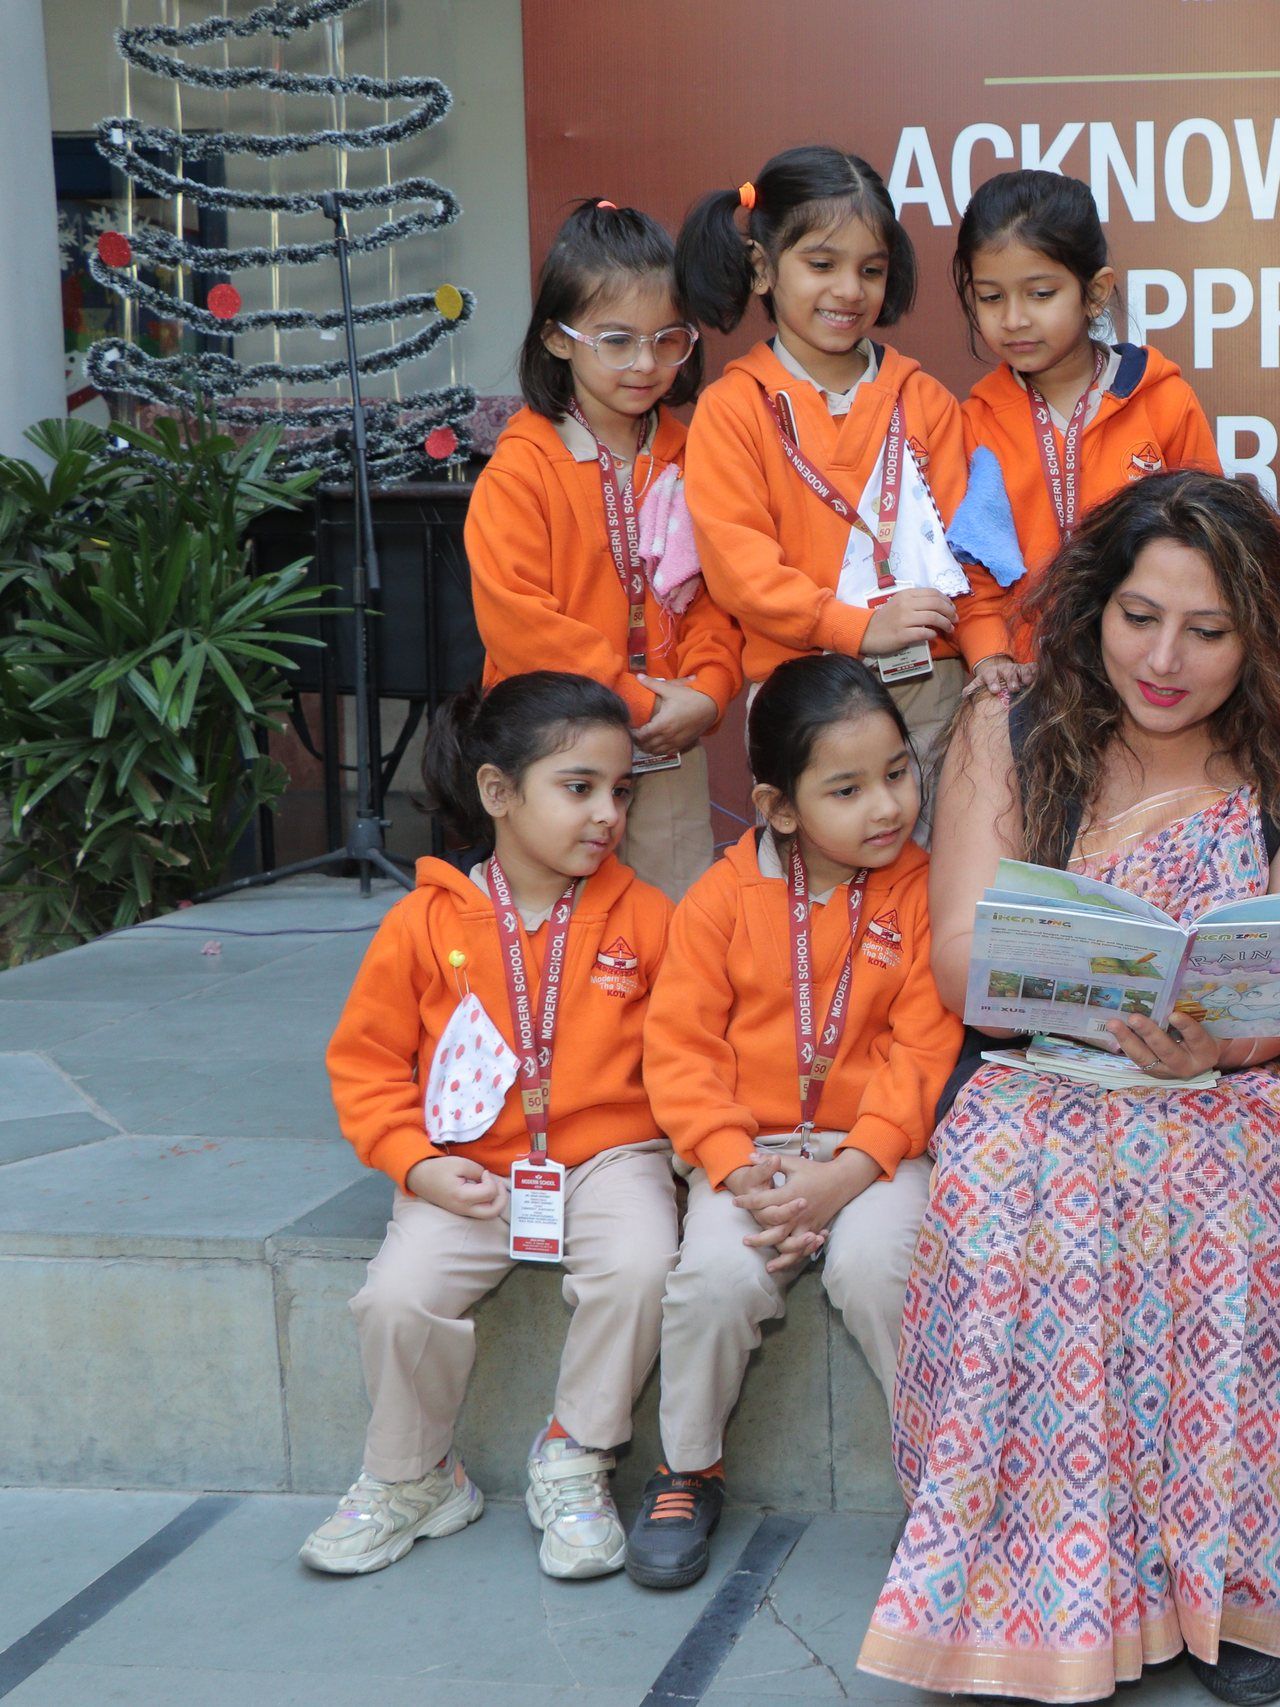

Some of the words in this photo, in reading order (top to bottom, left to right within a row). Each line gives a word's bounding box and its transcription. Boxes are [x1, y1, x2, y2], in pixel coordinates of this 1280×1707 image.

[885, 435, 900, 485] MODERN
[1042, 430, 1060, 476] SCHOOL
[1065, 423, 1079, 470] SCHOOL
[792, 455, 829, 498] MODERN
[1065, 472, 1076, 524] MODERN
[604, 479, 619, 526] SCHOOL
[1051, 478, 1065, 528] MODERN
[610, 529, 628, 579] MODERN
[625, 516, 640, 567] MODERN
[879, 527, 890, 537] 50
[633, 611, 643, 621] 50
[490, 865, 511, 906] MODERN
[794, 855, 804, 896] MODERN
[509, 939, 526, 992] SCHOOL
[548, 932, 566, 983] SCHOOL
[796, 929, 807, 980] SCHOOL
[867, 957, 887, 970] KOTA
[1189, 950, 1272, 967] RAIN
[542, 986, 557, 1040] MODERN
[607, 990, 626, 998] KOTA
[799, 982, 812, 1036] MODERN
[831, 963, 851, 1018] MODERN
[516, 995, 533, 1050] MODERN
[814, 1063, 828, 1075] 50
[528, 1096, 542, 1107] 50
